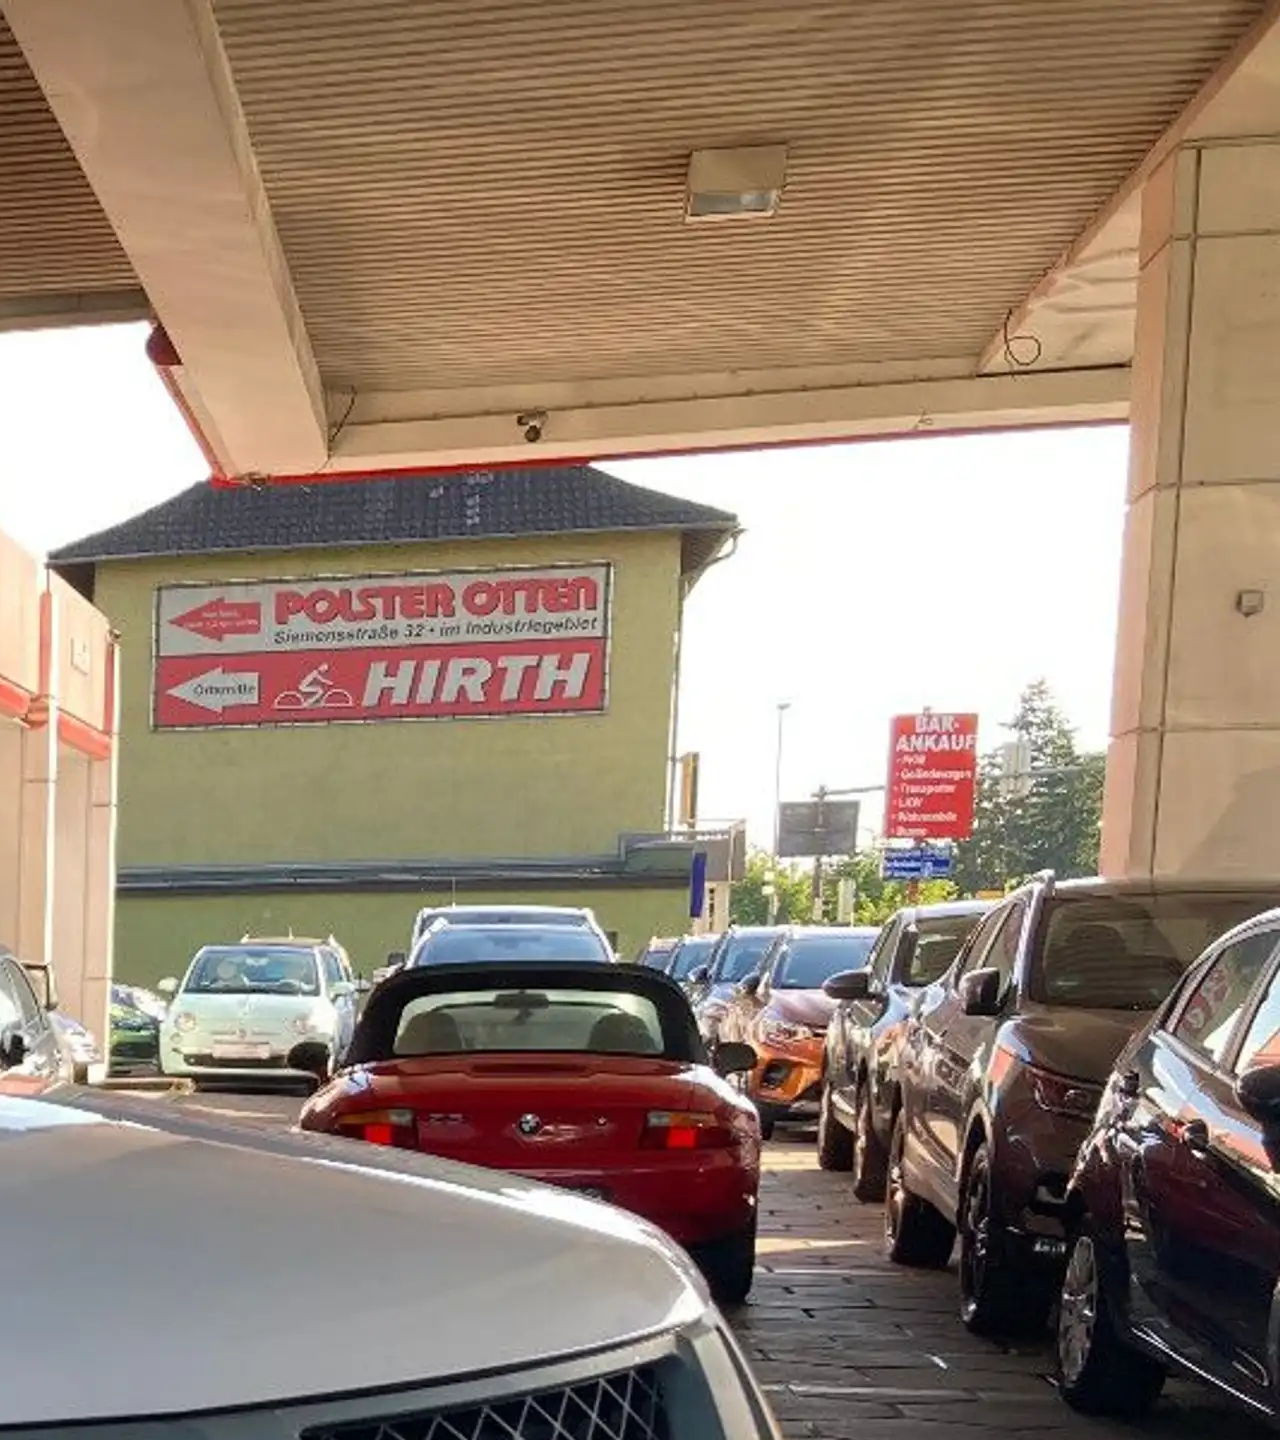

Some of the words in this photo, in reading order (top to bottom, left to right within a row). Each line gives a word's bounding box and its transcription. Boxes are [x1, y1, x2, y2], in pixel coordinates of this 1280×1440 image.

[274, 582, 456, 625] POLSTER
[462, 576, 598, 617] OTTEN
[361, 652, 590, 708] HIRTH
[895, 733, 977, 752] ANKAUF
